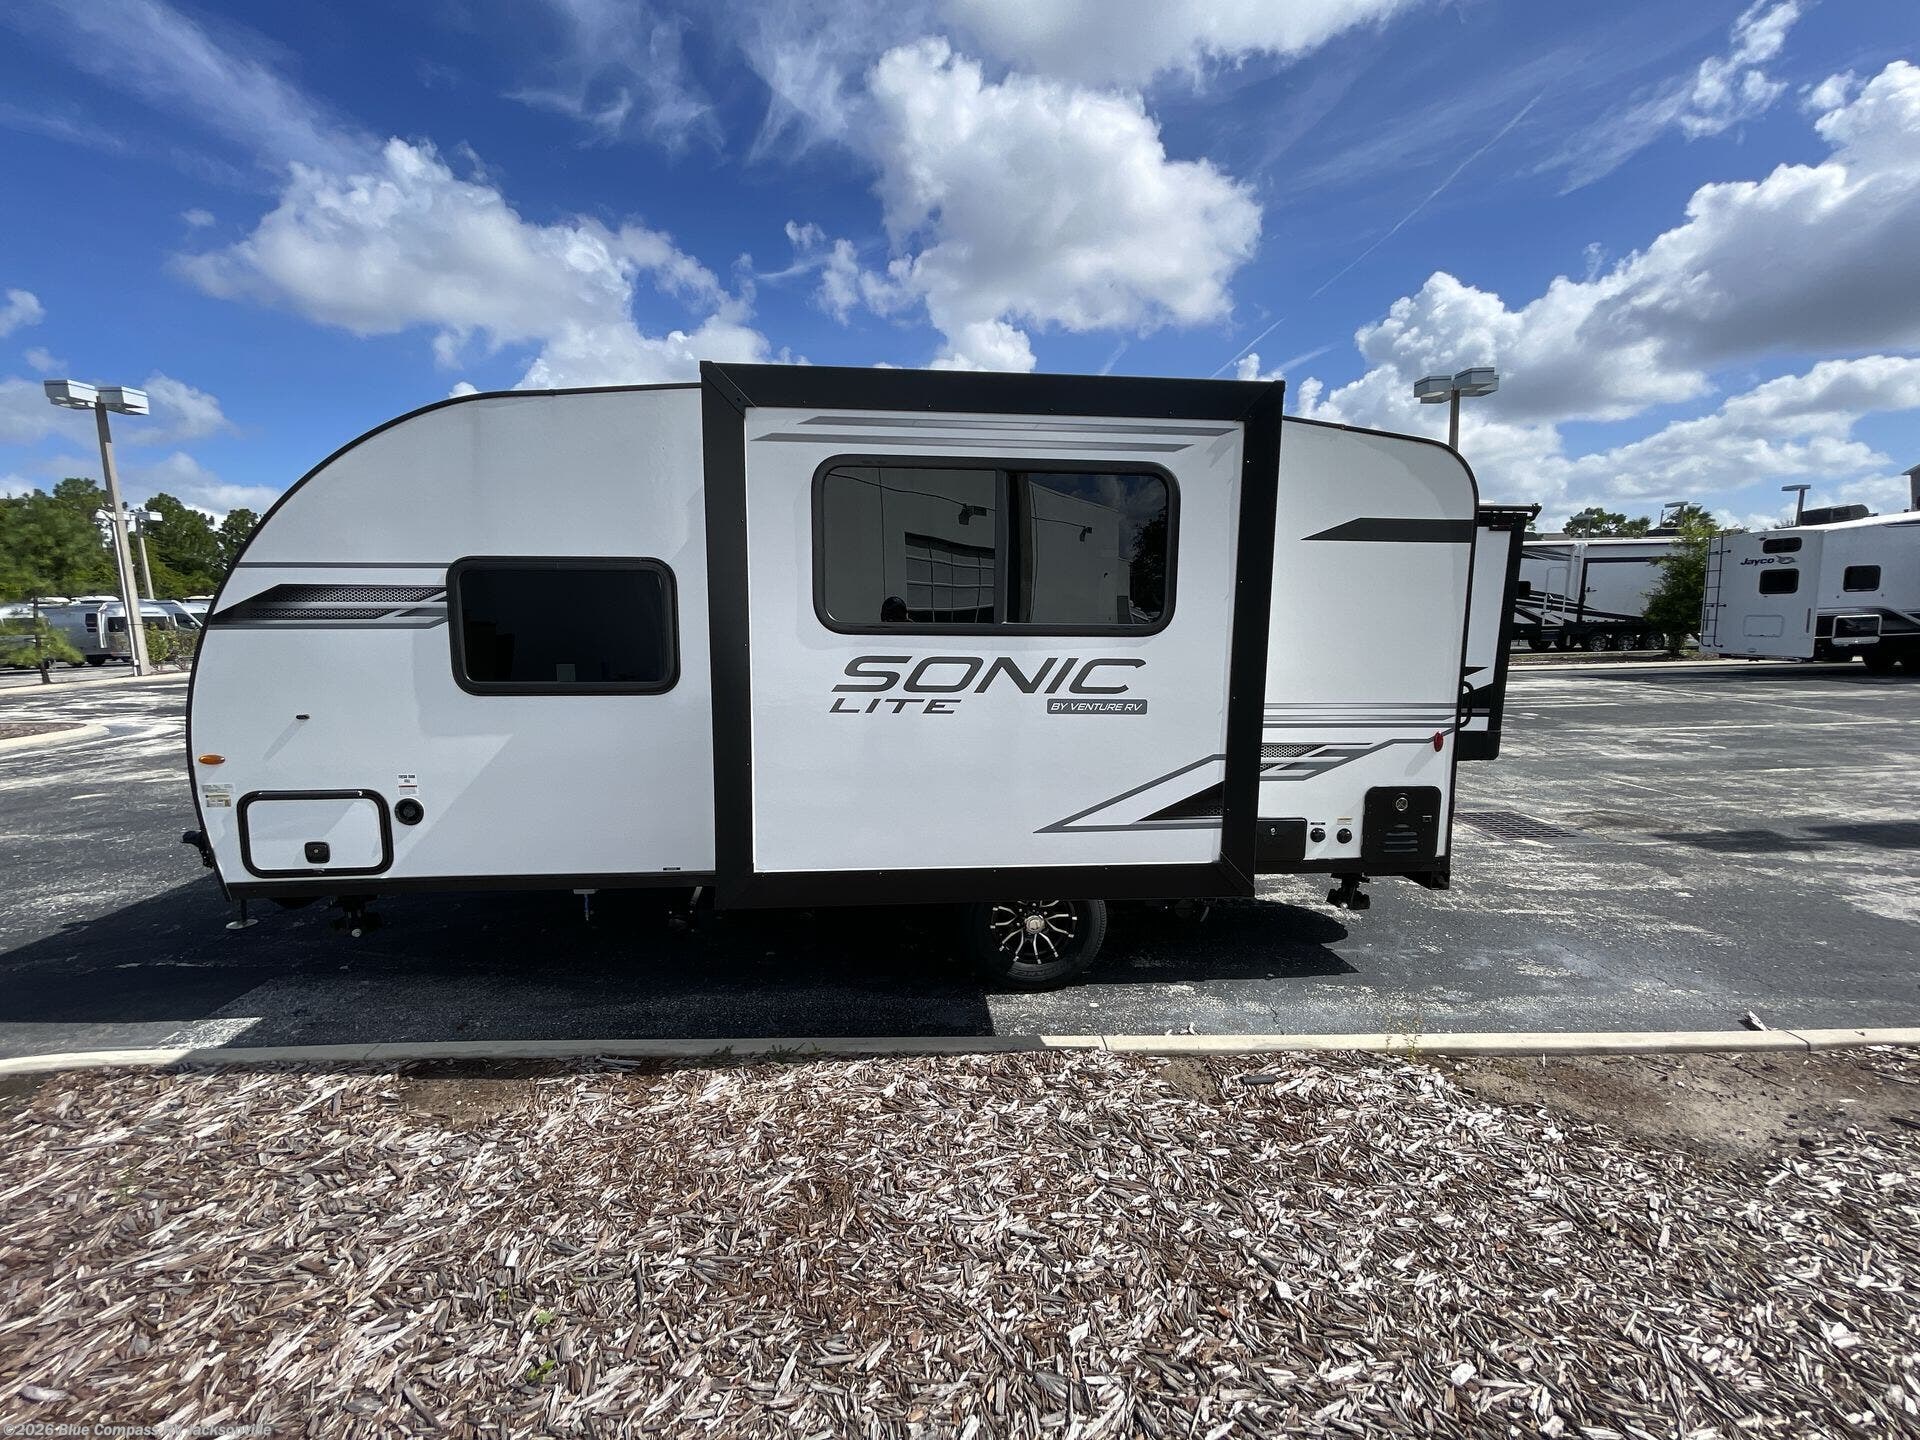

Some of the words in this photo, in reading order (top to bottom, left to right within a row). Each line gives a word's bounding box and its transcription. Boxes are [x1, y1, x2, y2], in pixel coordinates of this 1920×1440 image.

[1740, 557, 1775, 566] Jayco
[831, 655, 1147, 695] SONIC
[829, 698, 962, 714] LITE
[1051, 702, 1069, 711] BY
[1070, 702, 1124, 711] VENTURE
[1124, 703, 1143, 711] RV
